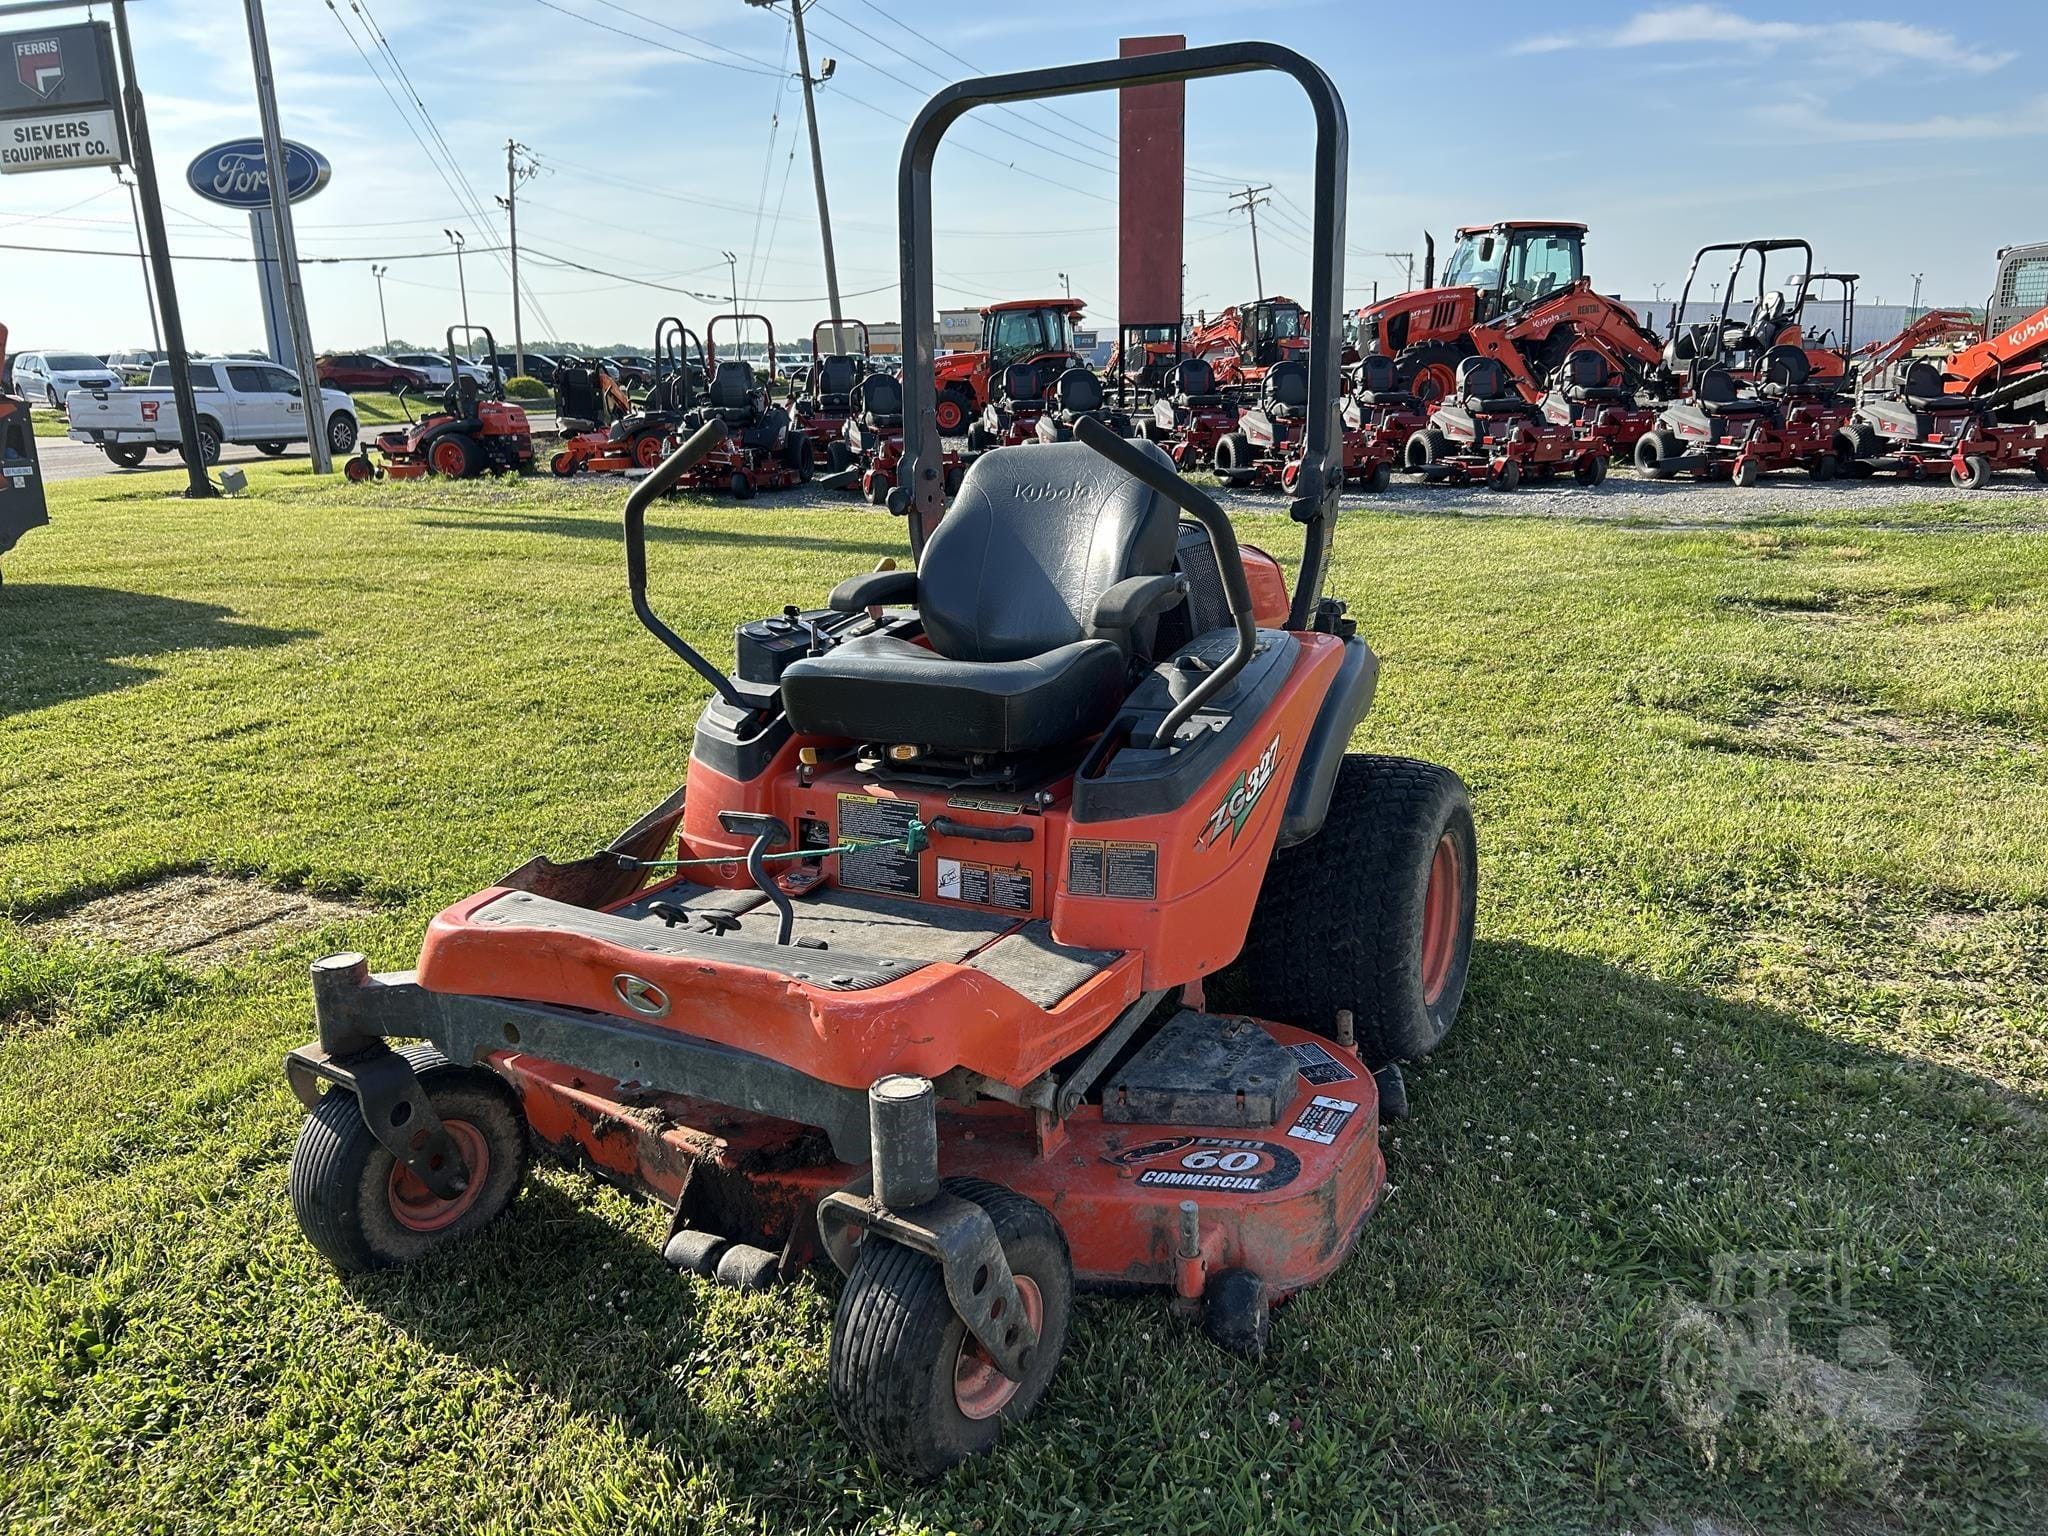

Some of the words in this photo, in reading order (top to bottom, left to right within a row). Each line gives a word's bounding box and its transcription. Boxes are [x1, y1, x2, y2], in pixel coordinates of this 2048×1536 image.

[17, 40, 58, 56] FERRIS
[13, 121, 90, 143] SIEVERS
[1, 143, 81, 163] EQUIPMENT
[85, 140, 110, 157] CO.
[1532, 314, 1560, 328] Kubota
[1013, 480, 1096, 507] Kubota
[1181, 1150, 1259, 1172] 60
[1141, 1170, 1261, 1190] COMMERCIAL
